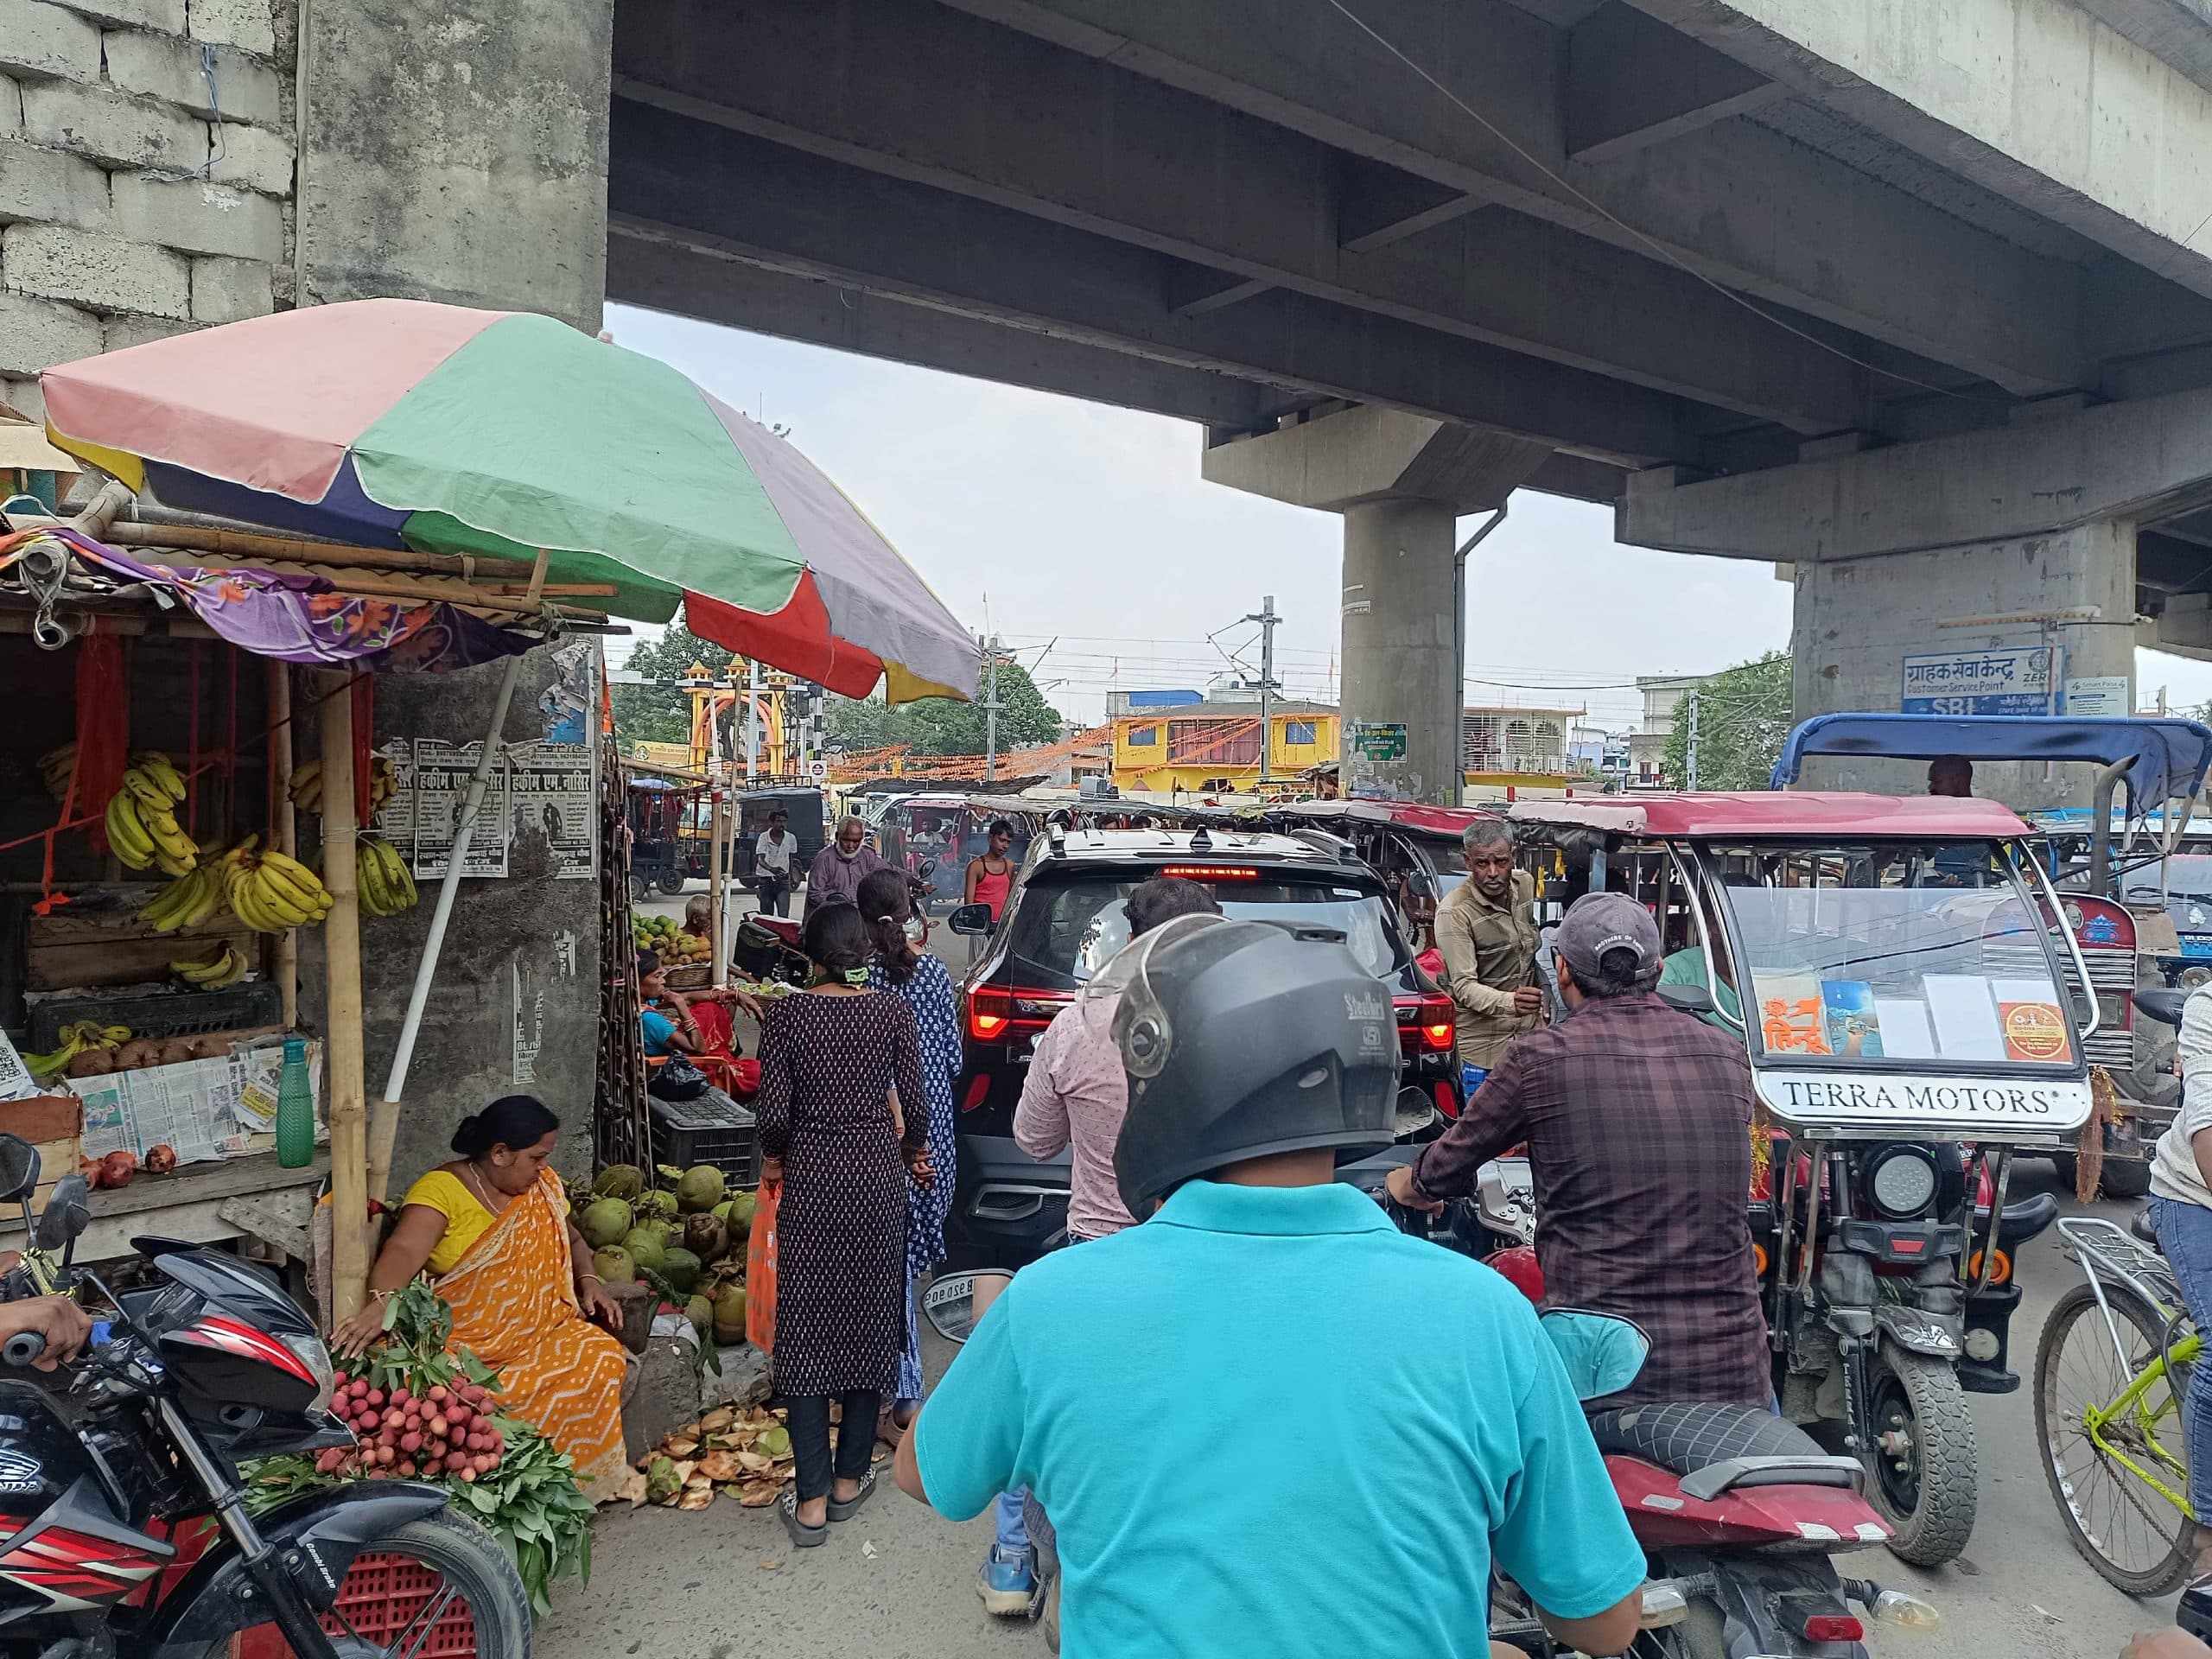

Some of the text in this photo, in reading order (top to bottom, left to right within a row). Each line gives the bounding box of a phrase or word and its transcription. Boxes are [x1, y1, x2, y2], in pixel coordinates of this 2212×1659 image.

[1907, 656, 2016, 683] ग्राहक सेवा केन्द्र
[1906, 681, 2005, 694] Customer Service Point
[512, 769, 541, 791] हकीम
[562, 769, 590, 791] नासिर
[1783, 1081, 2050, 1115] TERRA MOTORS
